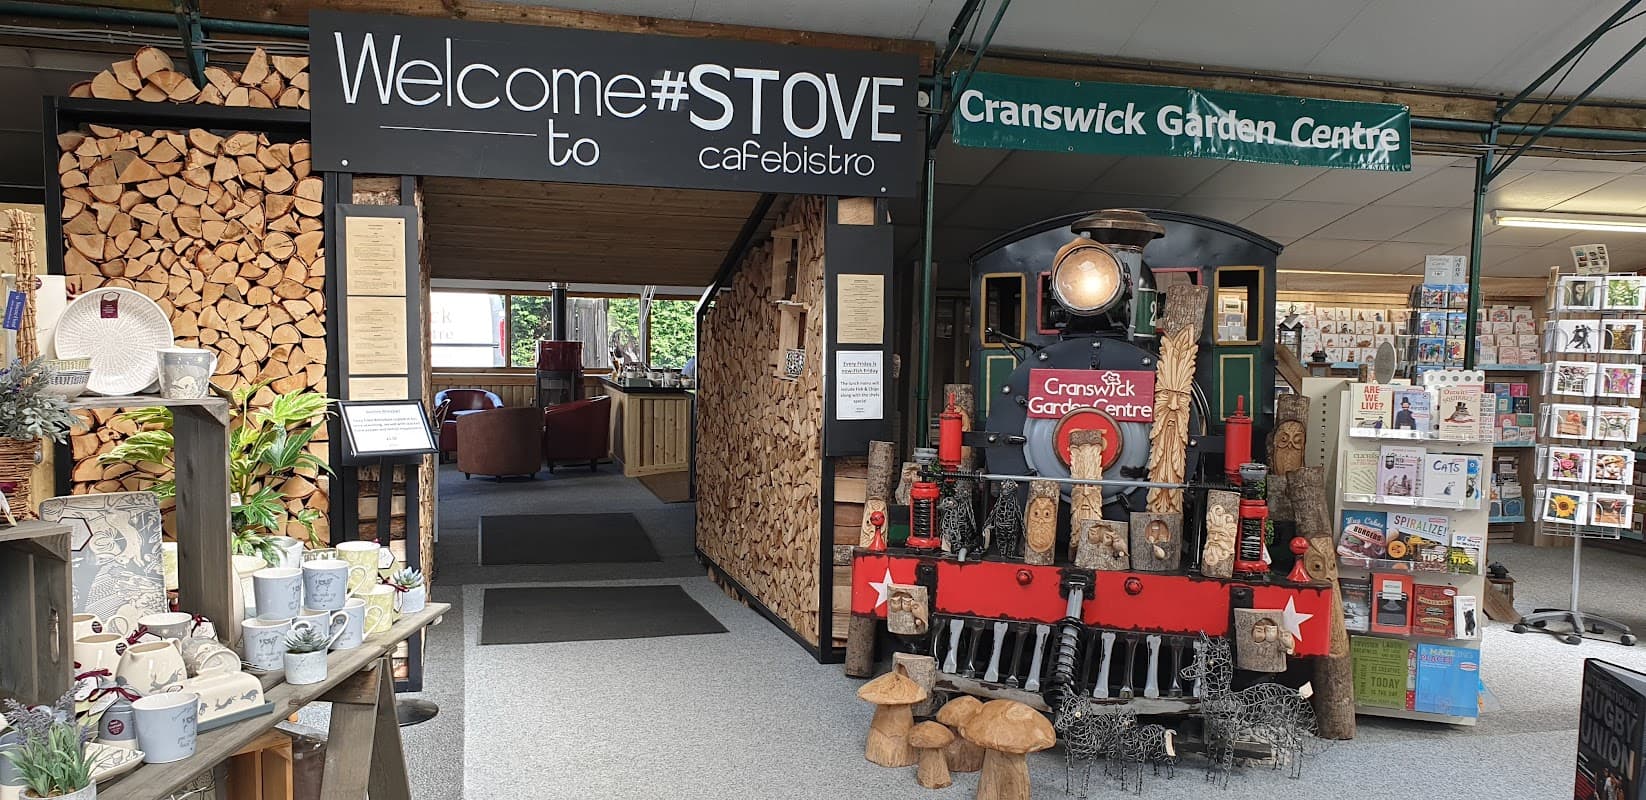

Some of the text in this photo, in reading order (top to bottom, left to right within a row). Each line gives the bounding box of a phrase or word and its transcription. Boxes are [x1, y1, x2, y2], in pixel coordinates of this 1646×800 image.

[334, 31, 647, 118] Welcome
[959, 90, 1400, 152] Cranswick Garden Centre
[548, 118, 600, 167] to
[698, 139, 875, 176] cafebistro
[1044, 375, 1135, 397] Cranswick
[1363, 385, 1381, 394] ARE
[1361, 402, 1385, 411] LIVE?
[1364, 394, 1379, 402] WE
[1393, 514, 1449, 537] SPIRALIZE!
[1420, 553, 1445, 563] TIPS
[1451, 556, 1476, 566] TIPS
[1371, 676, 1401, 689] TODAY
[1583, 684, 1637, 743] RUGBY
[1580, 713, 1635, 781] UNION
